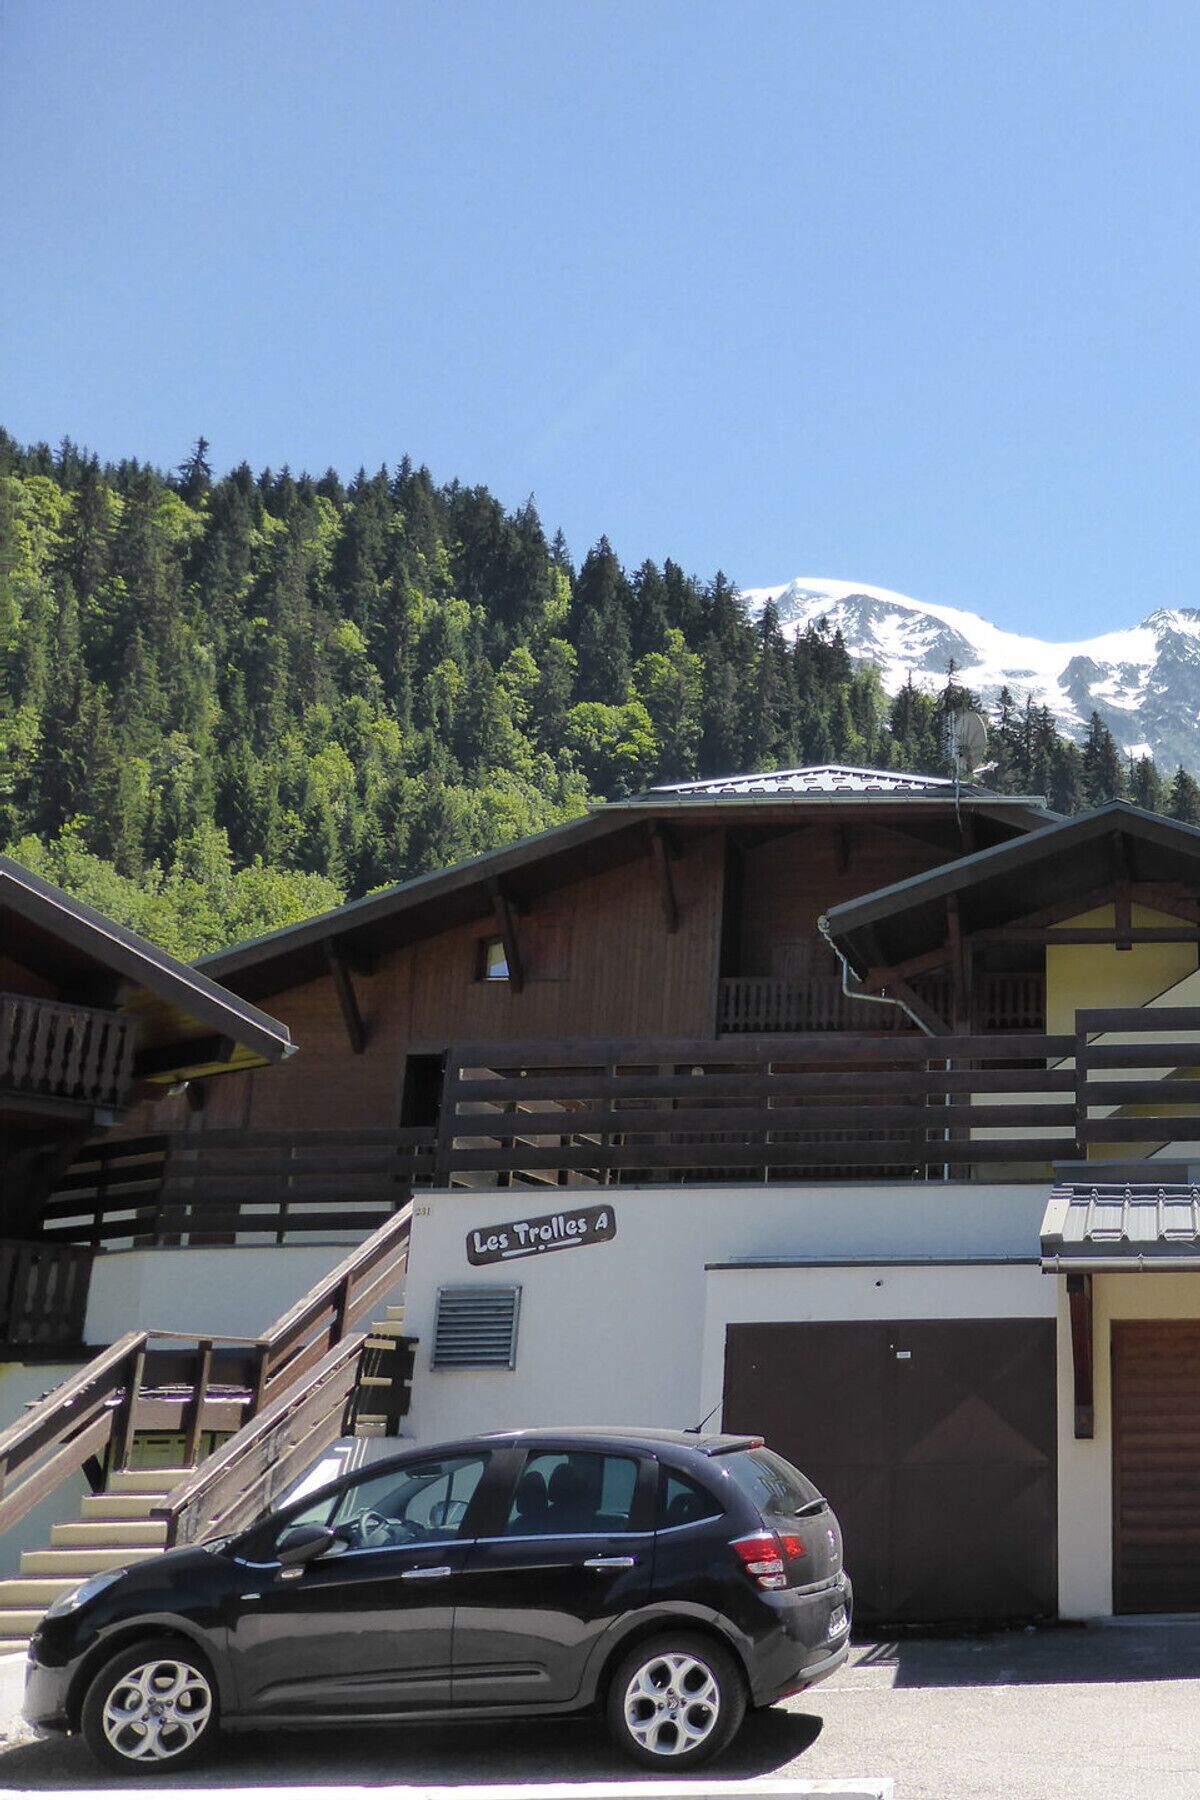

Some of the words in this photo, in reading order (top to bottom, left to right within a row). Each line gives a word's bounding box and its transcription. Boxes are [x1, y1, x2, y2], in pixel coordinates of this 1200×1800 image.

[473, 1232, 508, 1253] Les
[513, 1215, 588, 1245] Trolles
[595, 1212, 608, 1230] A
